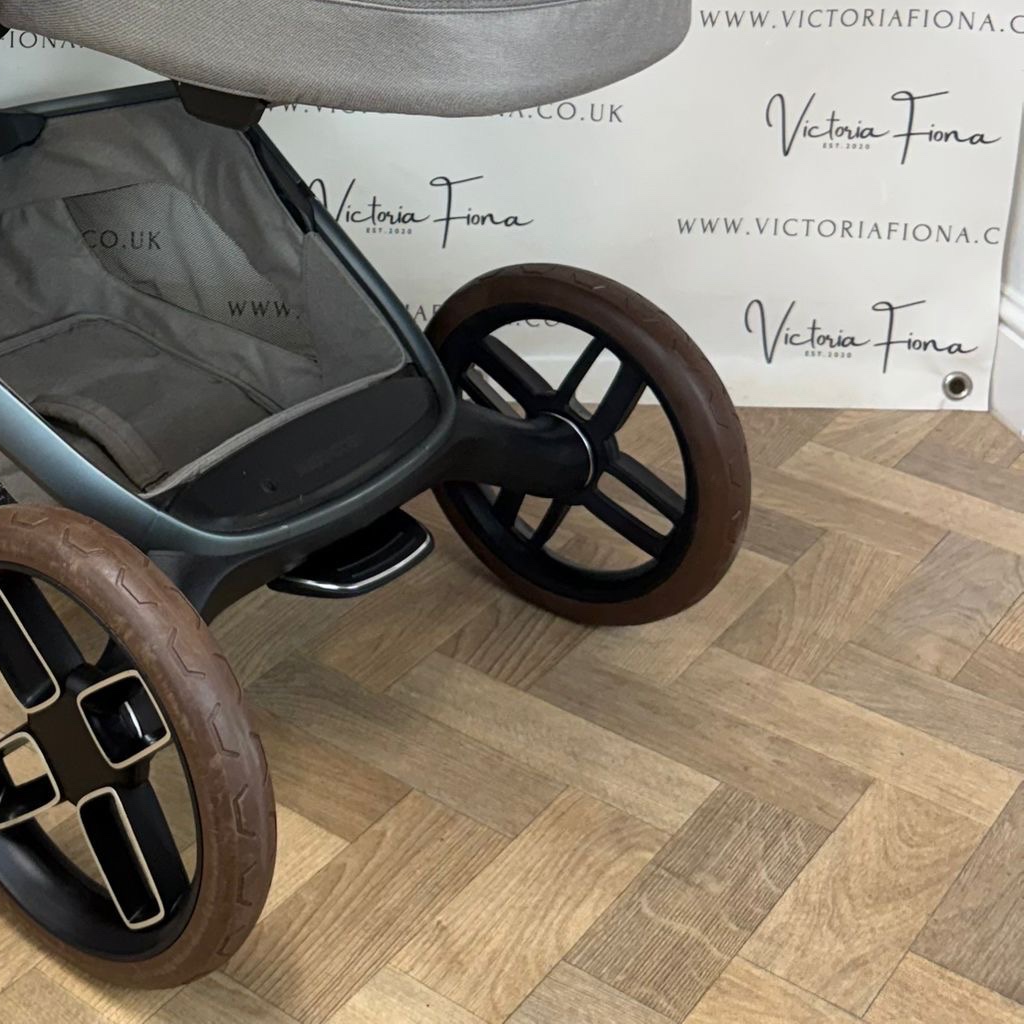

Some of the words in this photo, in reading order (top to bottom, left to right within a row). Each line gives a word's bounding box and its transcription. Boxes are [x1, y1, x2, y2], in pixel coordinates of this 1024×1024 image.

[765, 92, 890, 157] Victoria
[891, 90, 1002, 165] Fiona
[429, 175, 534, 249] Fiona
[677, 217, 1000, 245] WWW.VICTORIAFIONA.C
[744, 299, 871, 365] Victoria
[871, 300, 979, 374] Fiona
